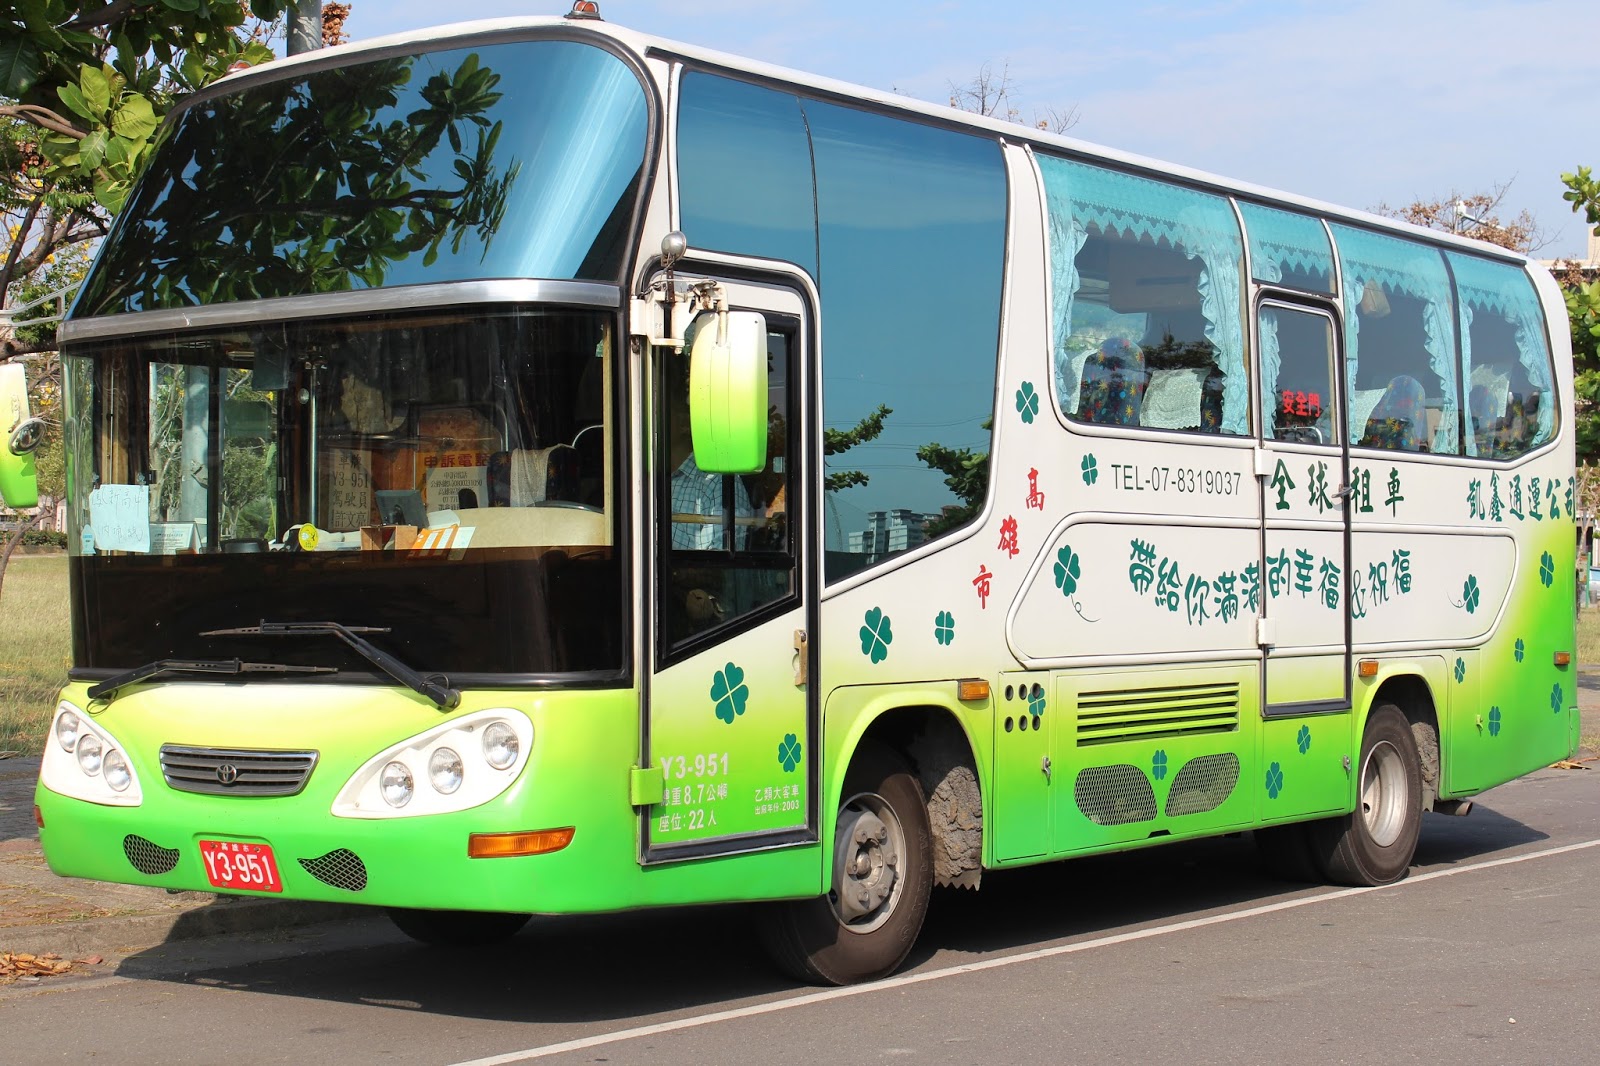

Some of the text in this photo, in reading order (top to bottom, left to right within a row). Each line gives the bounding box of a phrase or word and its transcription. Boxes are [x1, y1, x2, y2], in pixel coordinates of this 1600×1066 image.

[1282, 389, 1320, 418] 安全門
[332, 471, 368, 489] Y3-951
[1111, 463, 1242, 496] TEL-07-8319037
[1270, 458, 1405, 518] 全球租車
[332, 488, 368, 509] 駕駛員
[1466, 469, 1577, 524] 凱鑫通運公司
[971, 467, 1046, 610] 高雄市
[660, 751, 729, 780] Y3-951
[754, 784, 800, 803] 乙類大客車
[203, 851, 274, 885] Y3-951
